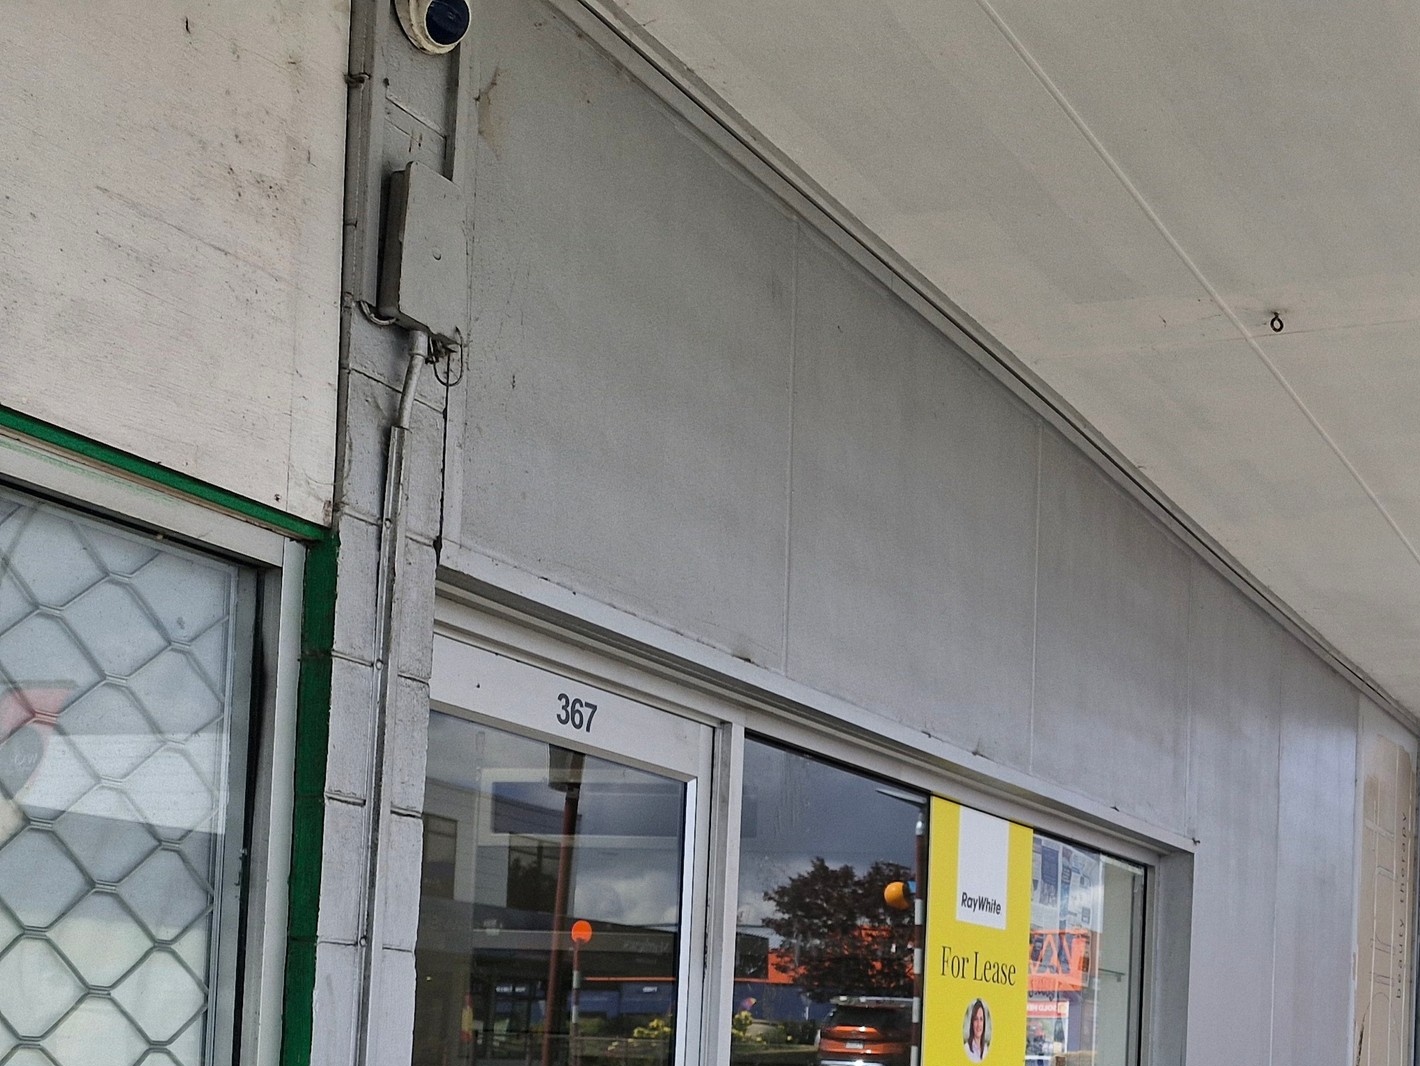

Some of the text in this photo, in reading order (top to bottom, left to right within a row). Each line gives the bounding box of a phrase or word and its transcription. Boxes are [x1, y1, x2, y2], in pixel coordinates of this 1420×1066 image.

[556, 693, 597, 733] 367
[941, 945, 1016, 986] For Lease
